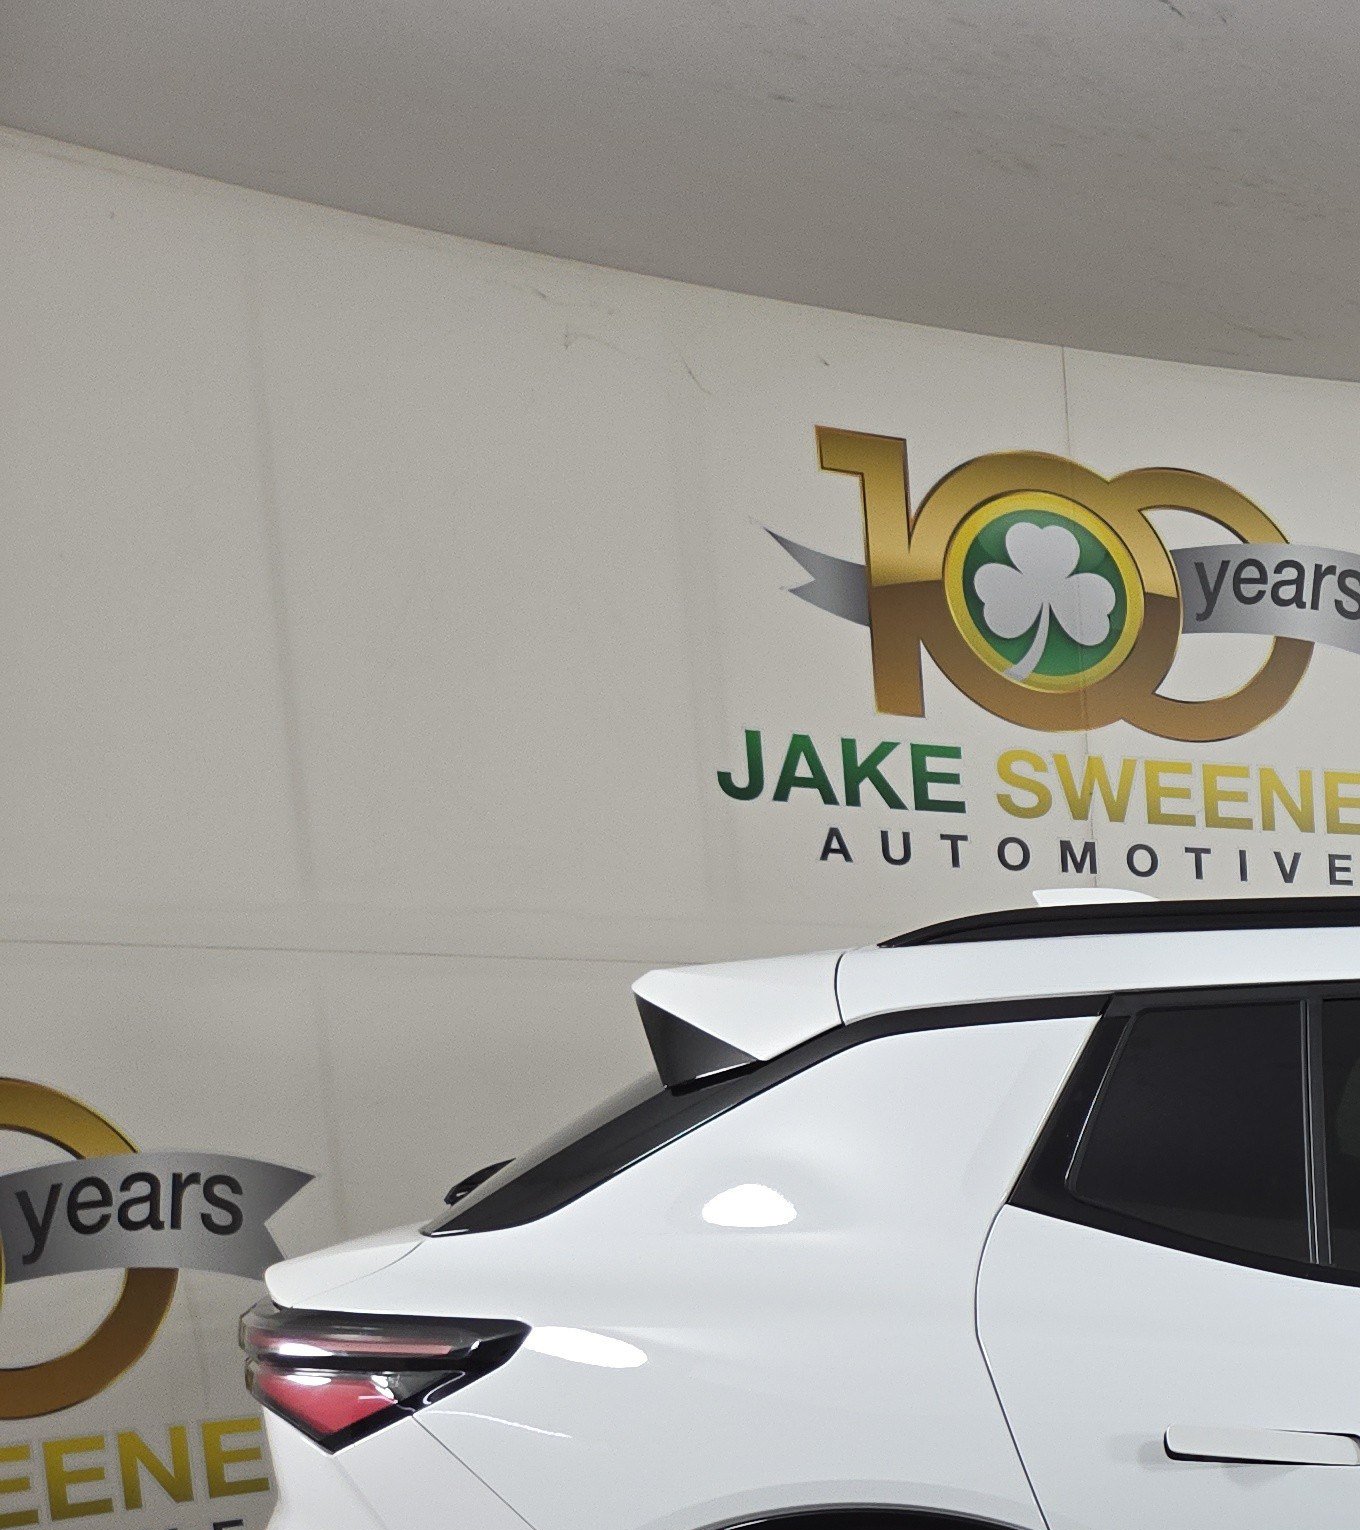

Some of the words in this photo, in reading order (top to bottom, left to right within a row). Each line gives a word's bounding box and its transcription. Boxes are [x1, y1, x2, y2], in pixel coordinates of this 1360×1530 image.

[716, 729, 967, 814] JAKE
[819, 826, 1355, 886] AUTOMOTIVE
[15, 1171, 245, 1265] years
